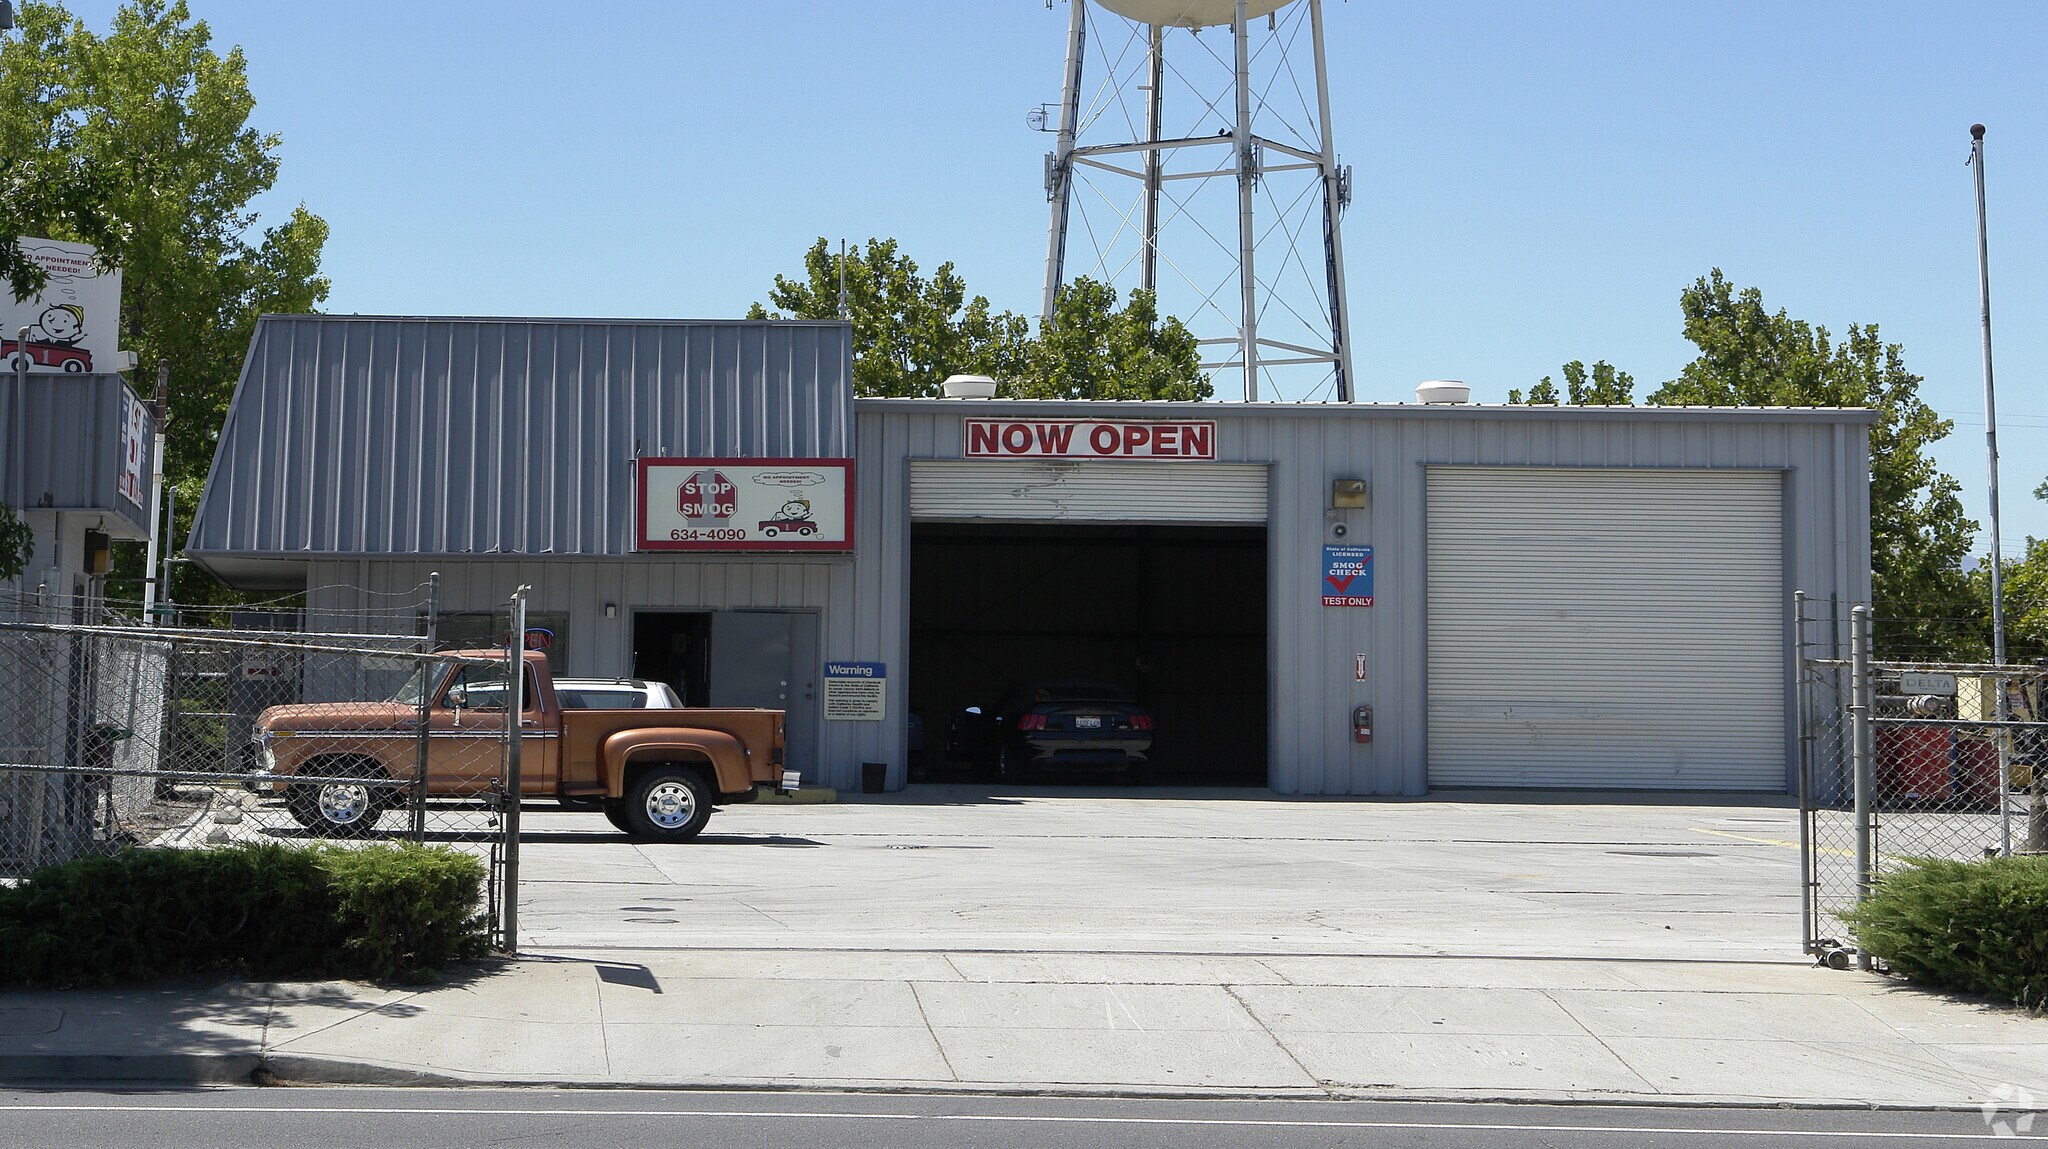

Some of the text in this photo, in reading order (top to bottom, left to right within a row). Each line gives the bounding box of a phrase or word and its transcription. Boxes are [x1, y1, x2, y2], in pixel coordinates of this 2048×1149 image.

[46, 265, 80, 274] NEEDED!
[970, 423, 1209, 456] NOW OPEN
[685, 483, 732, 495] STOP
[682, 503, 734, 515] SMOG
[670, 529, 746, 540] 634-4090
[1323, 597, 1372, 606] TEST ONLY
[829, 665, 873, 676] Warning
[1906, 679, 1950, 688] DELTA
